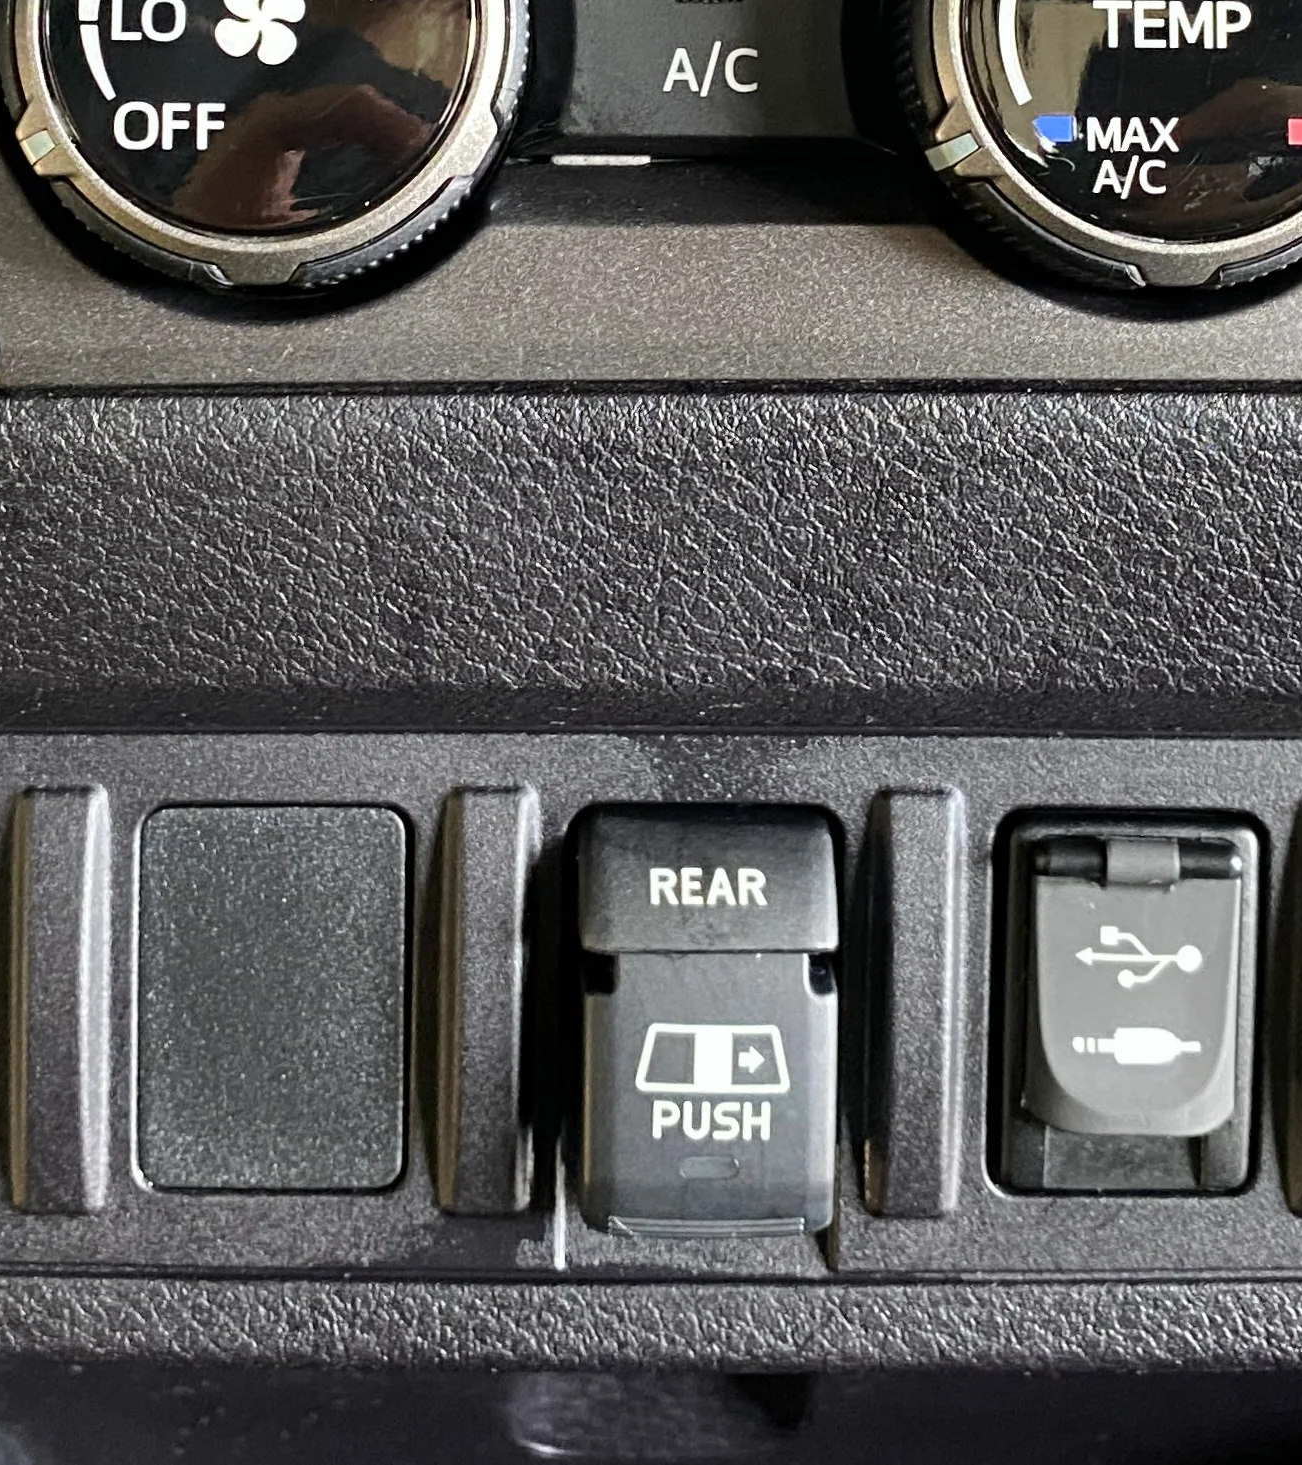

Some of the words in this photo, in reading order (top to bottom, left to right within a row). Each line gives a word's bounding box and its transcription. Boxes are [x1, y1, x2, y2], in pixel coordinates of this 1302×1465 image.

[1092, 0, 1252, 50] TEMP
[662, 40, 759, 98] A/C
[112, 101, 227, 151] OFF
[1085, 117, 1180, 153] MAX
[1092, 156, 1167, 200] A/C
[649, 867, 768, 907] REAR
[651, 1100, 772, 1141] PUSH
